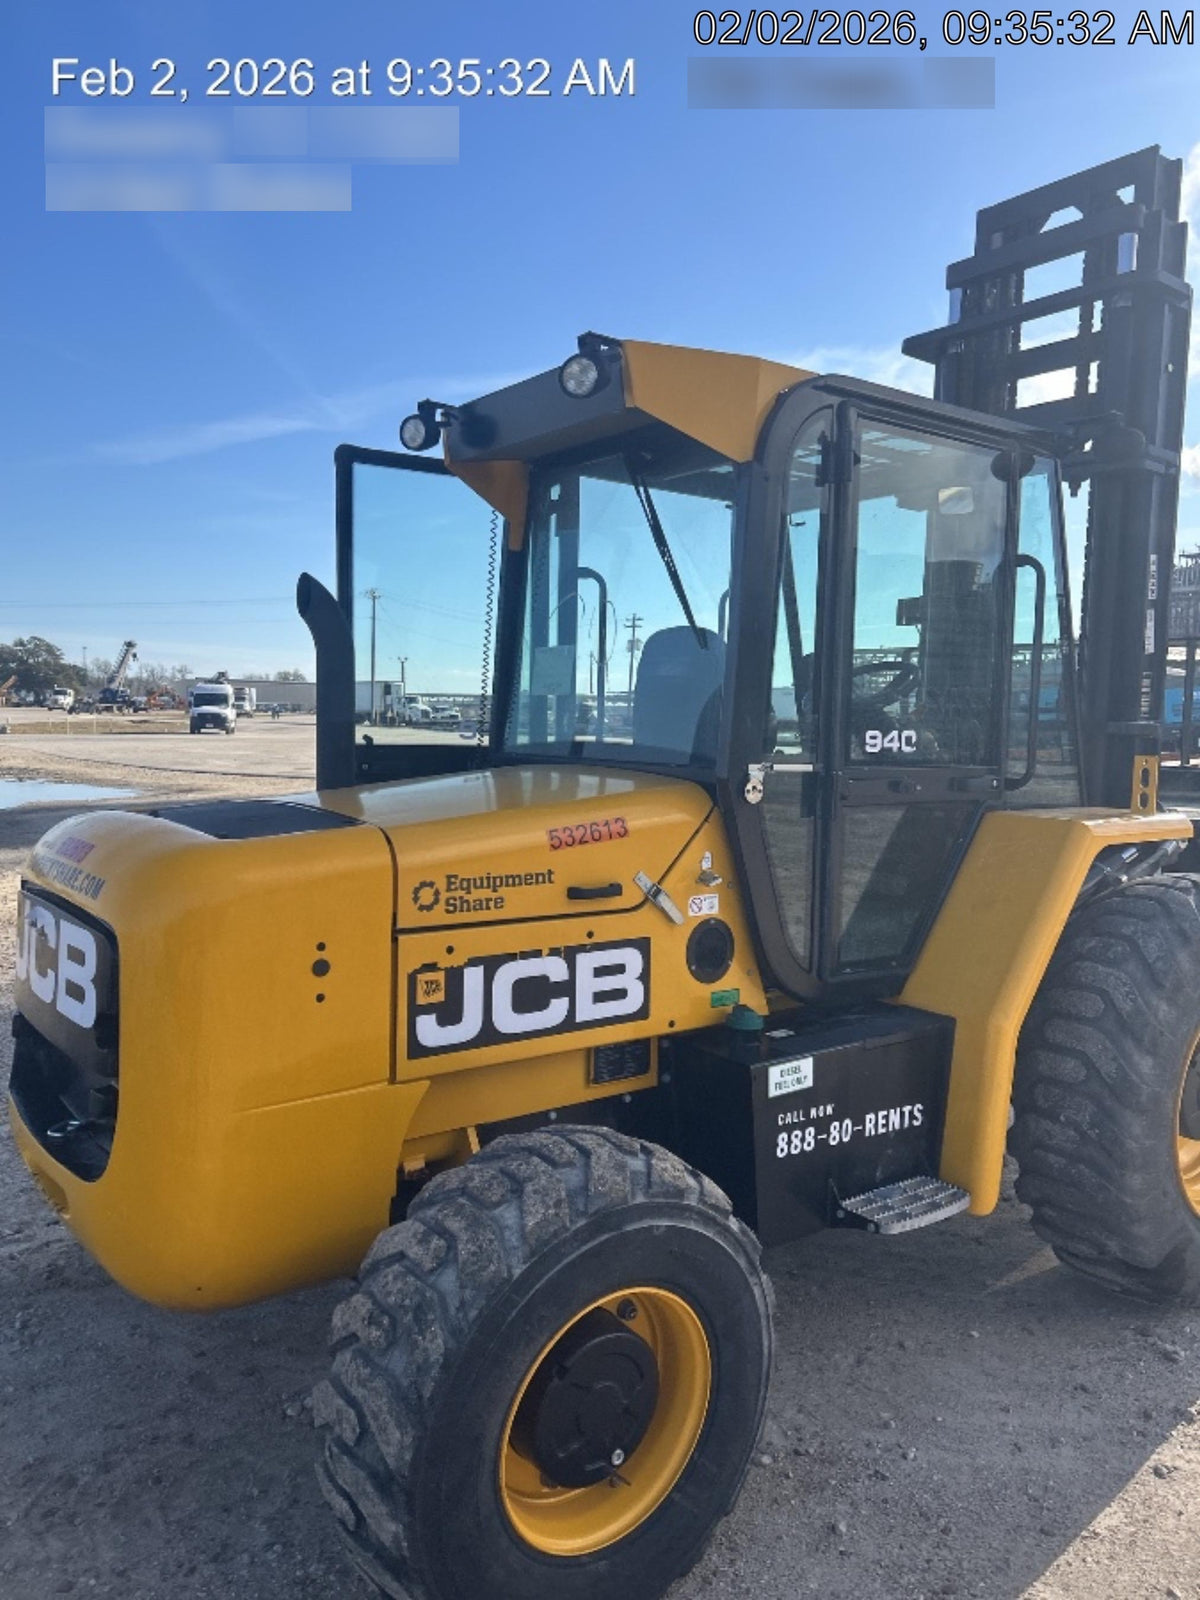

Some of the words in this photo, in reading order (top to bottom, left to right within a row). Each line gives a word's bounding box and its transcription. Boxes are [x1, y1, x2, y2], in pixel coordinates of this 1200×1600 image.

[549, 817, 628, 850] 532613
[444, 869, 555, 895] Equipment
[443, 894, 505, 914] Share
[16, 898, 97, 1029] JCB
[415, 947, 645, 1048] JCB
[775, 1103, 924, 1158] 888-80-RENTS
[777, 1111, 806, 1126] CALL
